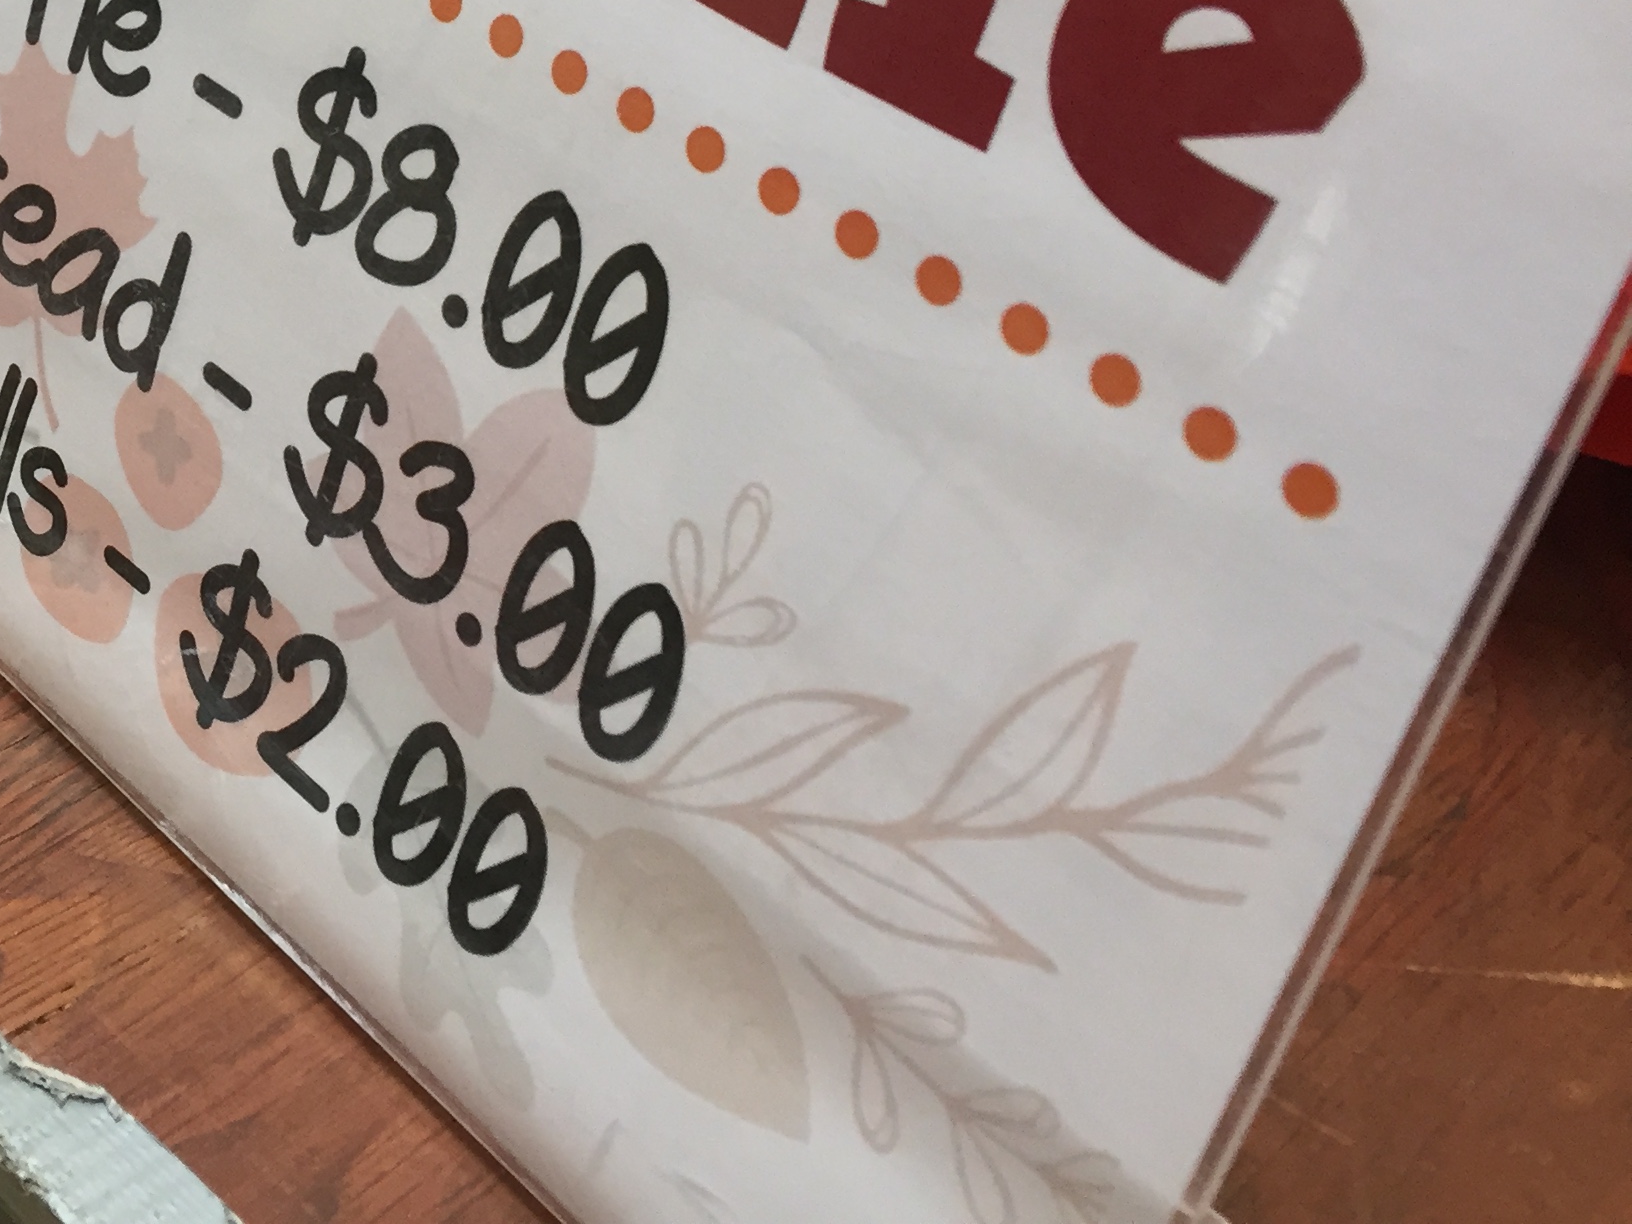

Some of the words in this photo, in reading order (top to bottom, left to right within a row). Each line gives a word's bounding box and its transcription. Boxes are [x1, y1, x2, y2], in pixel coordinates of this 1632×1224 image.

[272, 46, 670, 426] $8.00
[178, 548, 548, 956] $2.00
[283, 352, 685, 763] $3.00
